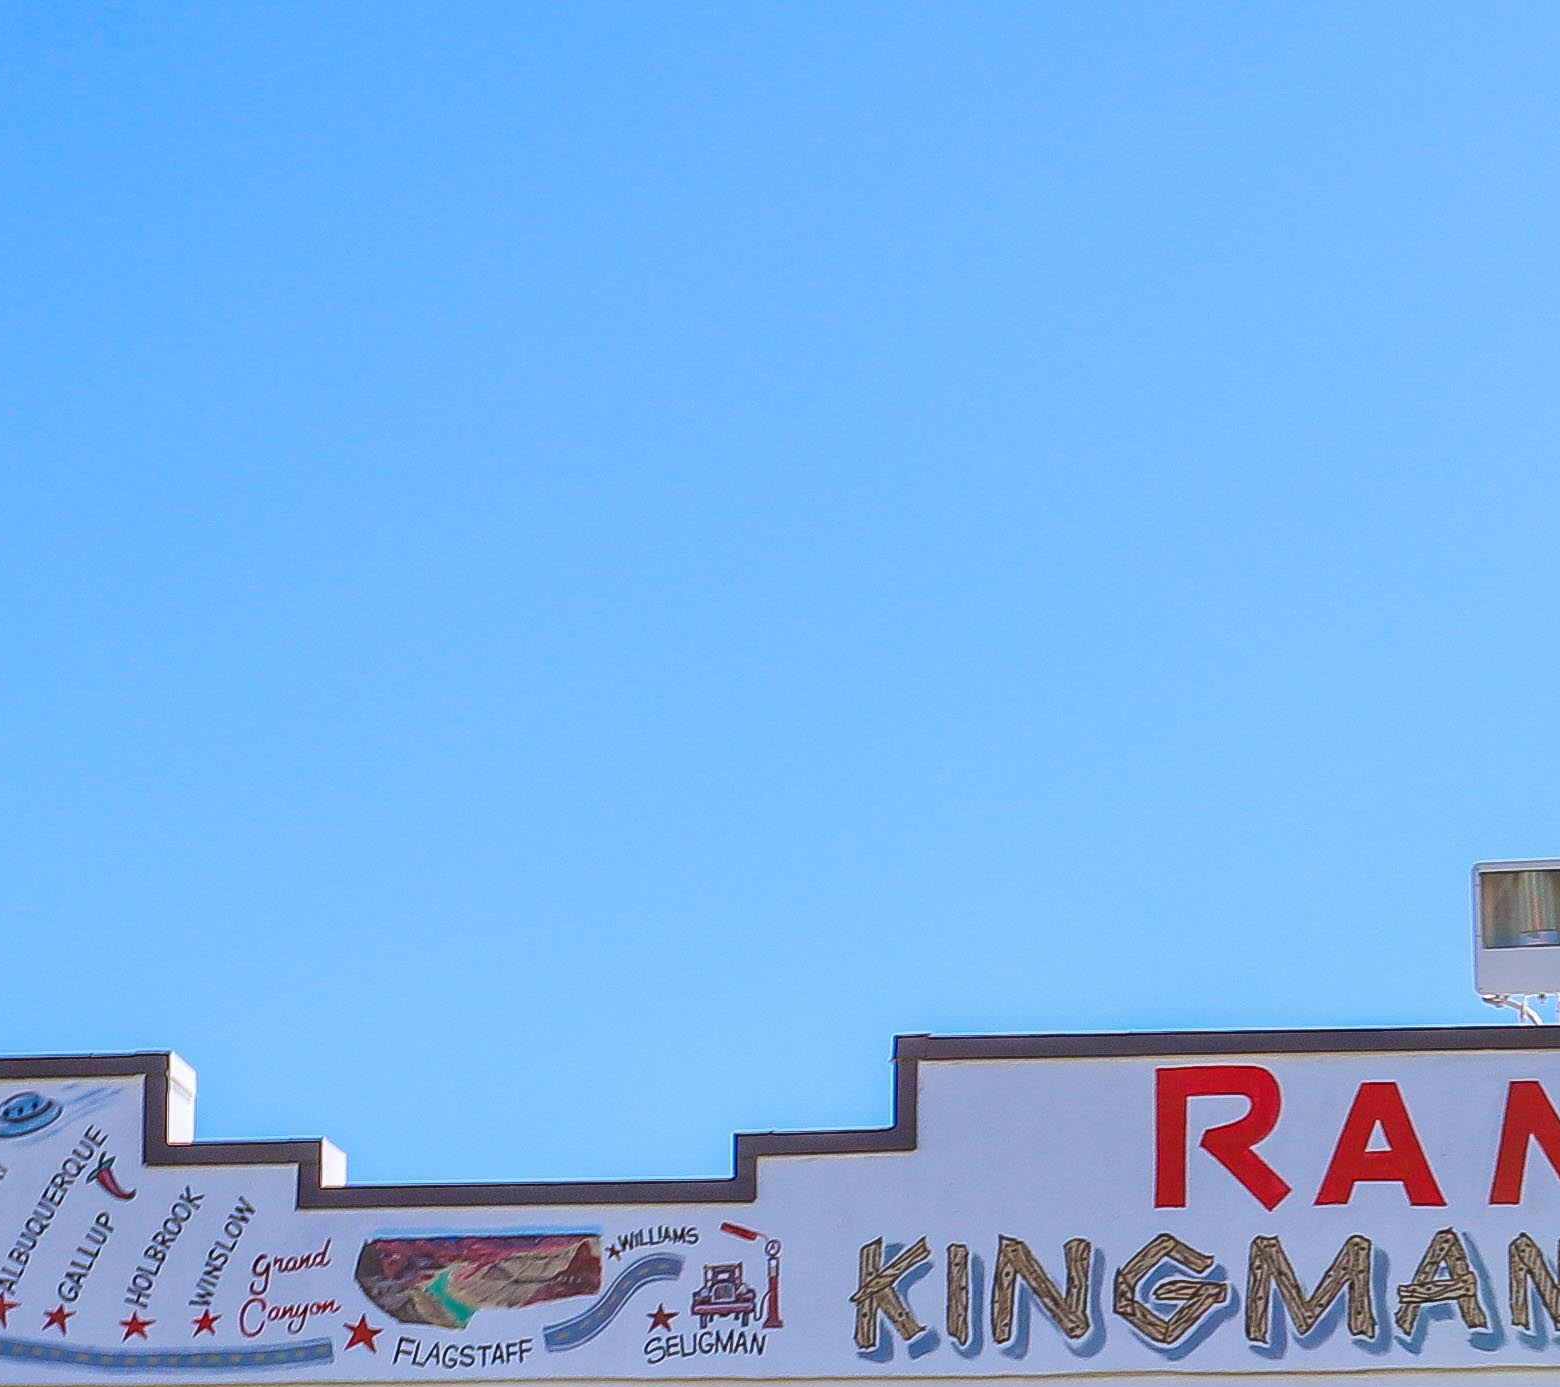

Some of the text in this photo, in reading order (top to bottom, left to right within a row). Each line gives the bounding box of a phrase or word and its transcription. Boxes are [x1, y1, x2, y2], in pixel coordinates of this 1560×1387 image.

[57, 1210, 116, 1303] GALLUP
[124, 1185, 206, 1308] HOLBROOK
[188, 1195, 258, 1308] WINSLOW
[249, 1238, 332, 1293] Grand
[618, 1225, 700, 1251] WILLIAMS
[239, 1298, 342, 1338] Canyon
[392, 1336, 534, 1368] FLAGSTAFF
